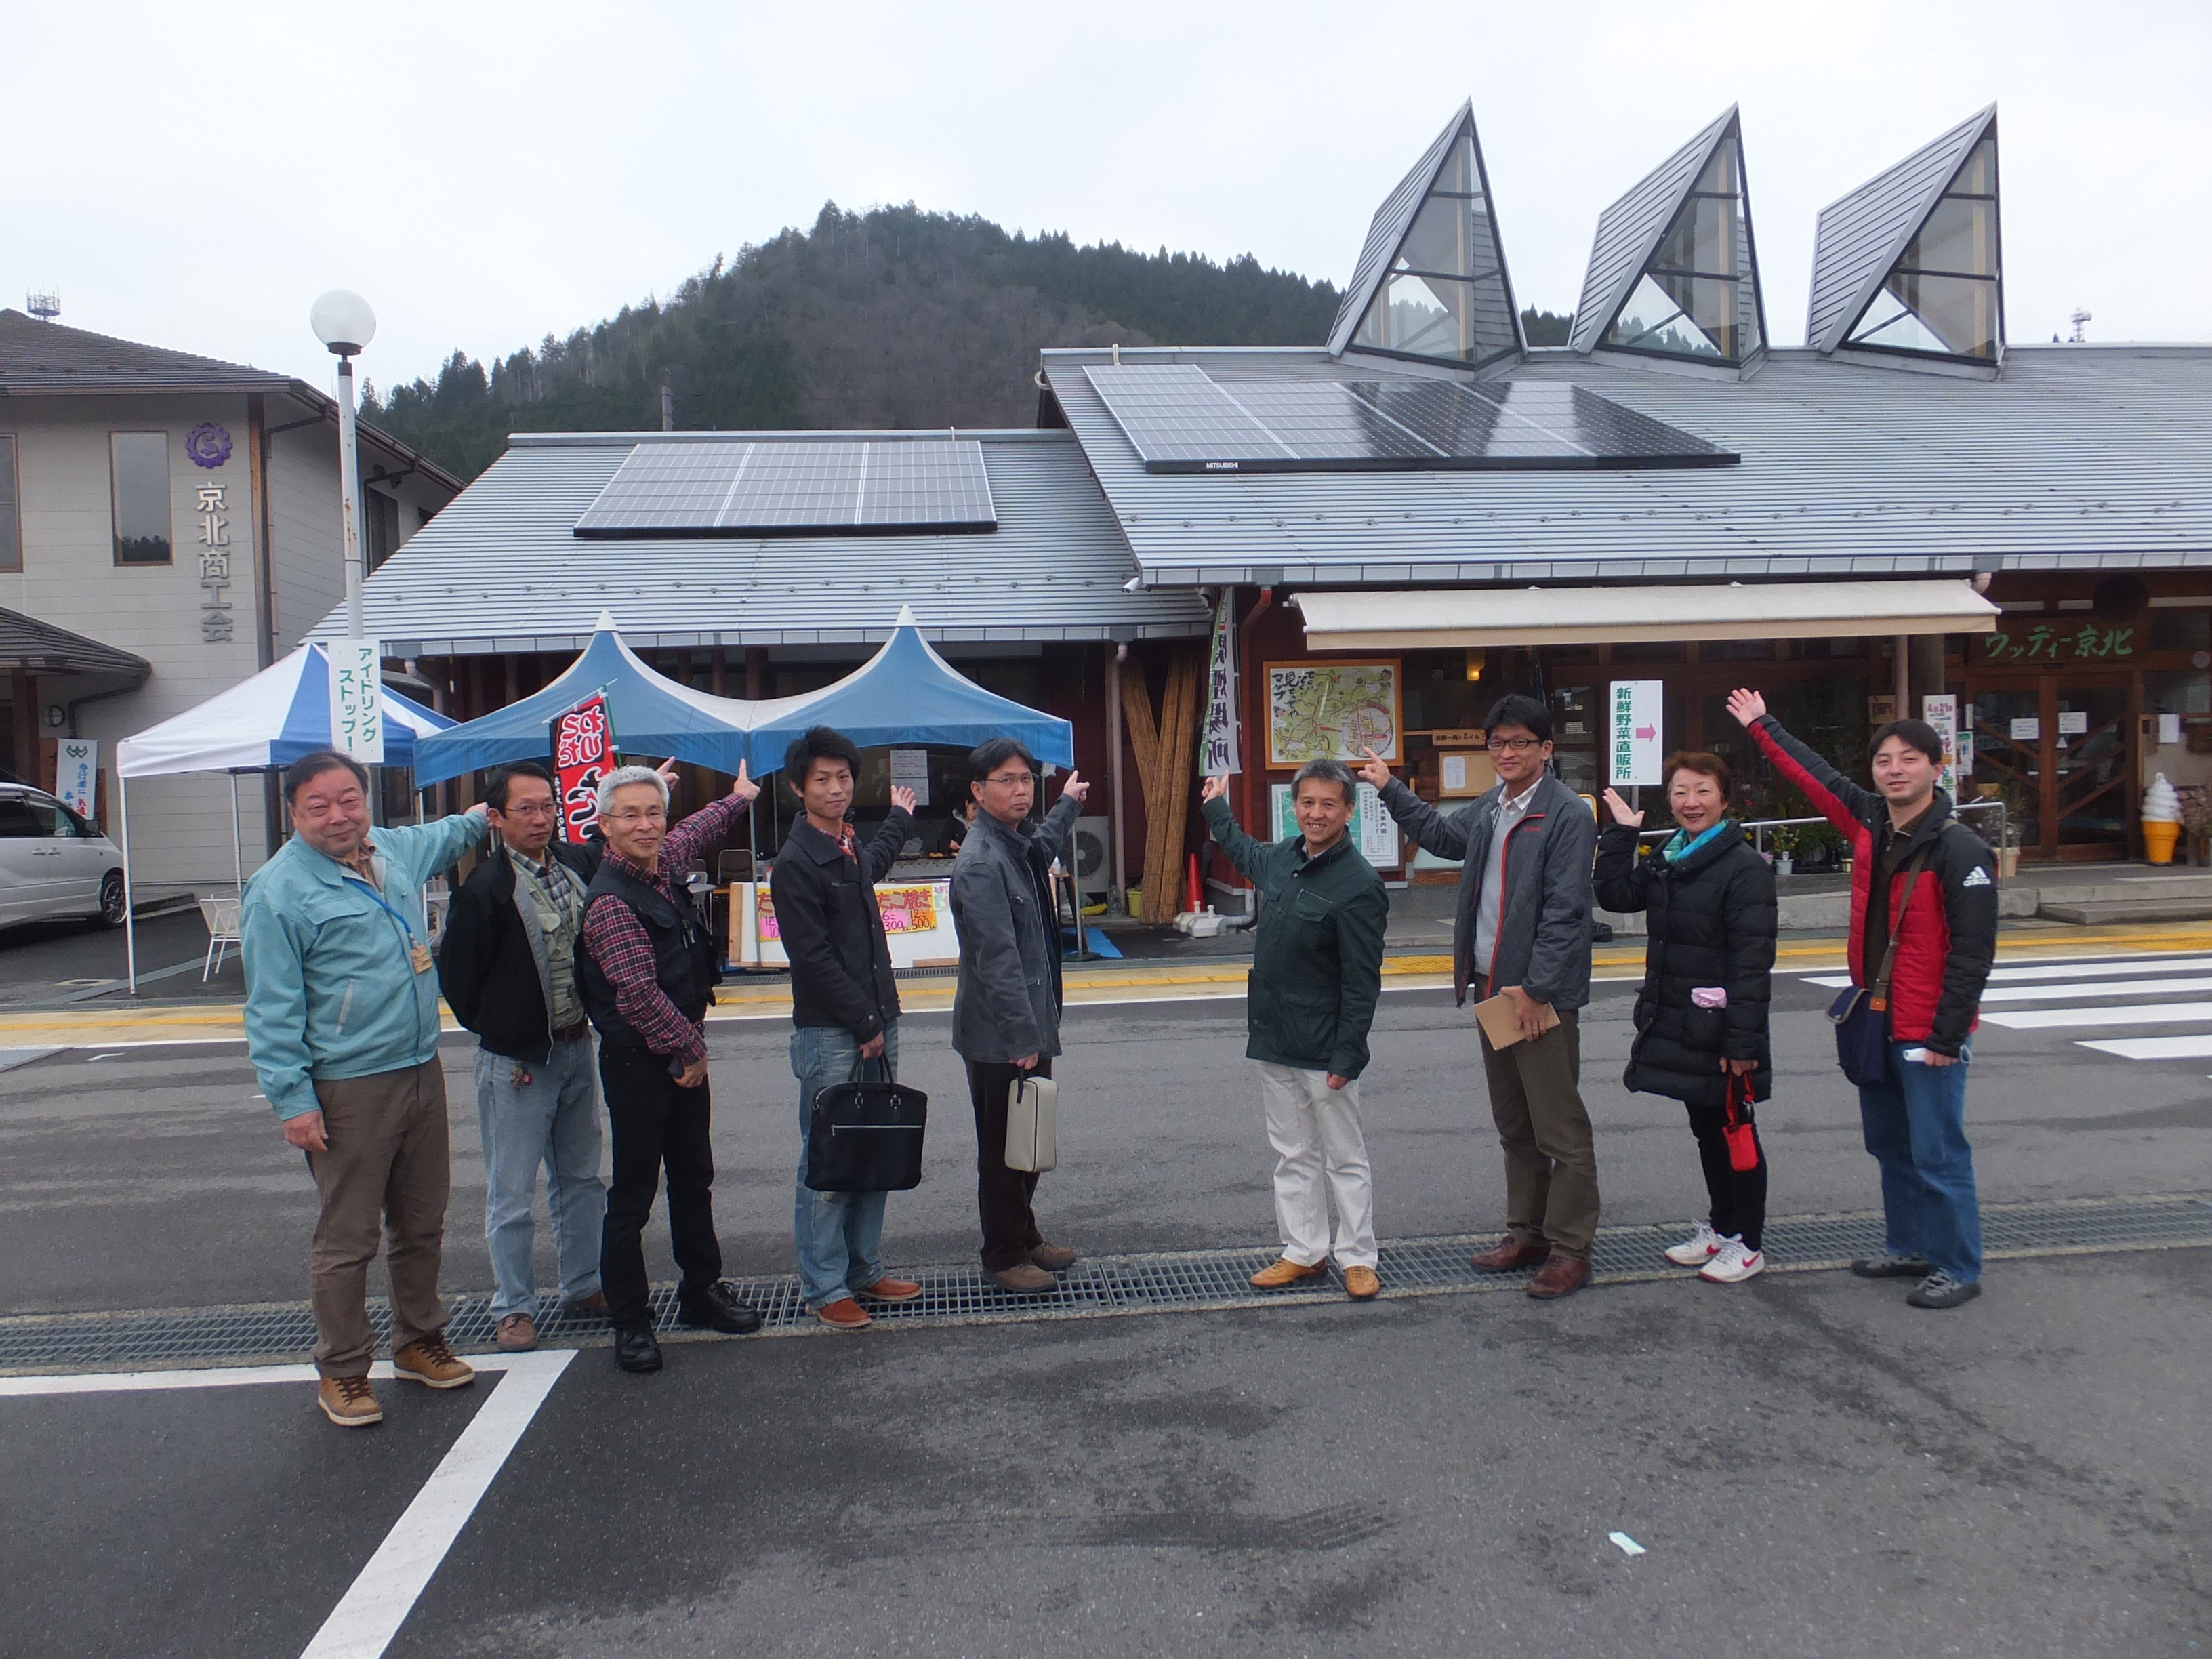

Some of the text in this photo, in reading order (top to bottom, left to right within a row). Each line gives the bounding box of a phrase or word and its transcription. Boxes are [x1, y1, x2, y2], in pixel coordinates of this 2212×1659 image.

[195, 481, 233, 642] 京北商工会
[340, 670, 357, 752] ストップ！
[359, 647, 377, 743] アイドリング
[1616, 687, 1632, 779] 新鮮野菜直販所
[876, 888, 932, 910] たこ焼き
